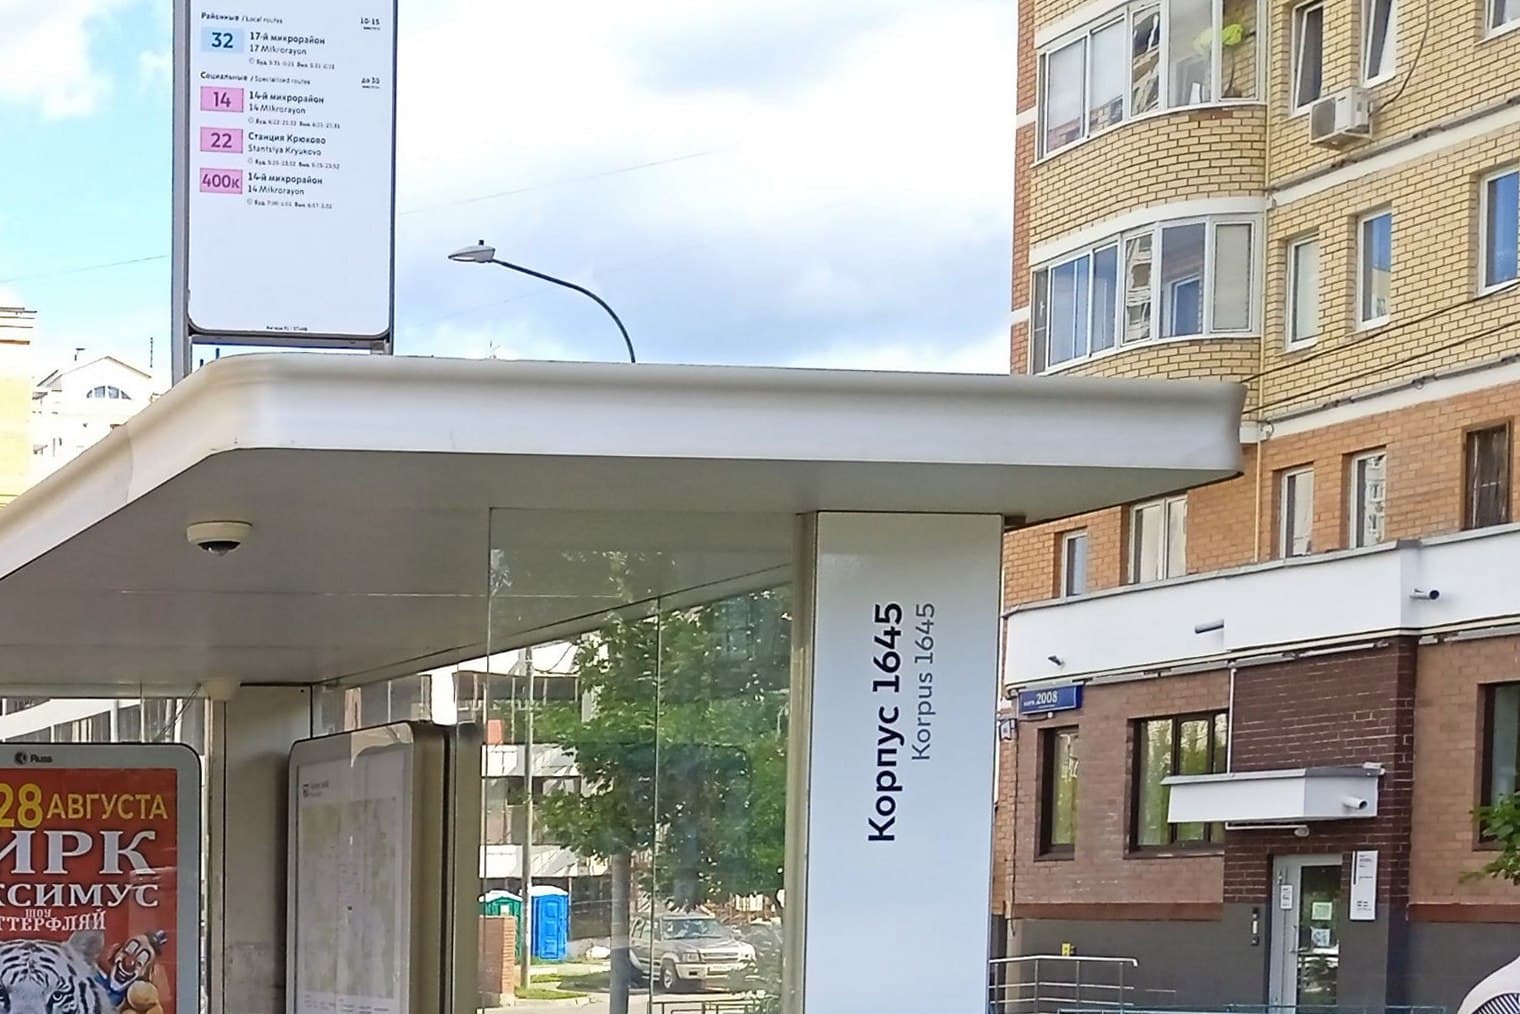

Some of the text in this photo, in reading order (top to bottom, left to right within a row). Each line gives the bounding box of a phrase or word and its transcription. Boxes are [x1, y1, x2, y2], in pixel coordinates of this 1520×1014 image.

[211, 32, 233, 48] 32
[250, 32, 325, 45] 17-й микрорайон
[250, 44, 307, 56] 17 Mikrorayon
[213, 91, 231, 108] 14
[249, 91, 324, 104] 14-й микрорайон
[249, 104, 306, 115] 14 Mikrorayon
[211, 132, 232, 149] 22
[248, 132, 326, 145] Станция Крюково
[248, 172, 323, 185] 14-й микрорайон
[247, 184, 304, 196] 14 Mikrorayon
[911, 603, 937, 760] Korpus 1645
[1036, 690, 1058, 705] 2008
[868, 602, 905, 842] Корпус 1645
[46, 793, 168, 820] АВГУСТА
[25, 908, 51, 919] ШОУ
